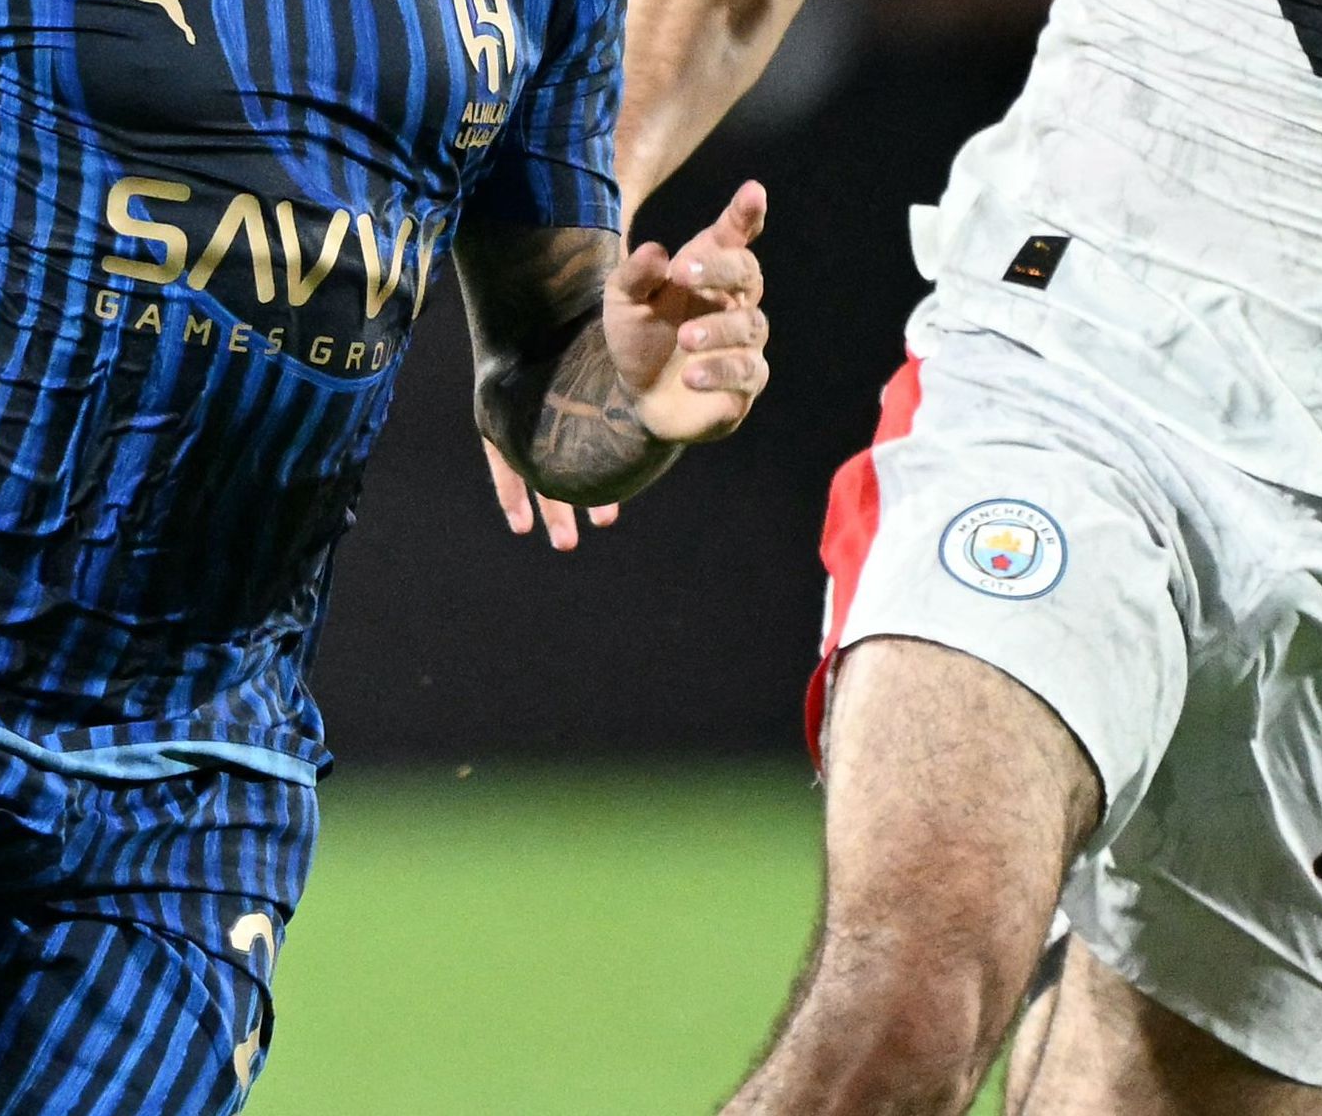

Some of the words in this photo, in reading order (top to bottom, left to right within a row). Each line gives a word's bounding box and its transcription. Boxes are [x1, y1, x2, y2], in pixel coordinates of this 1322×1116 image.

[94, 289, 284, 355] GAMES
[958, 508, 1055, 545] MANCHESTER
[979, 578, 1014, 592] CITY
